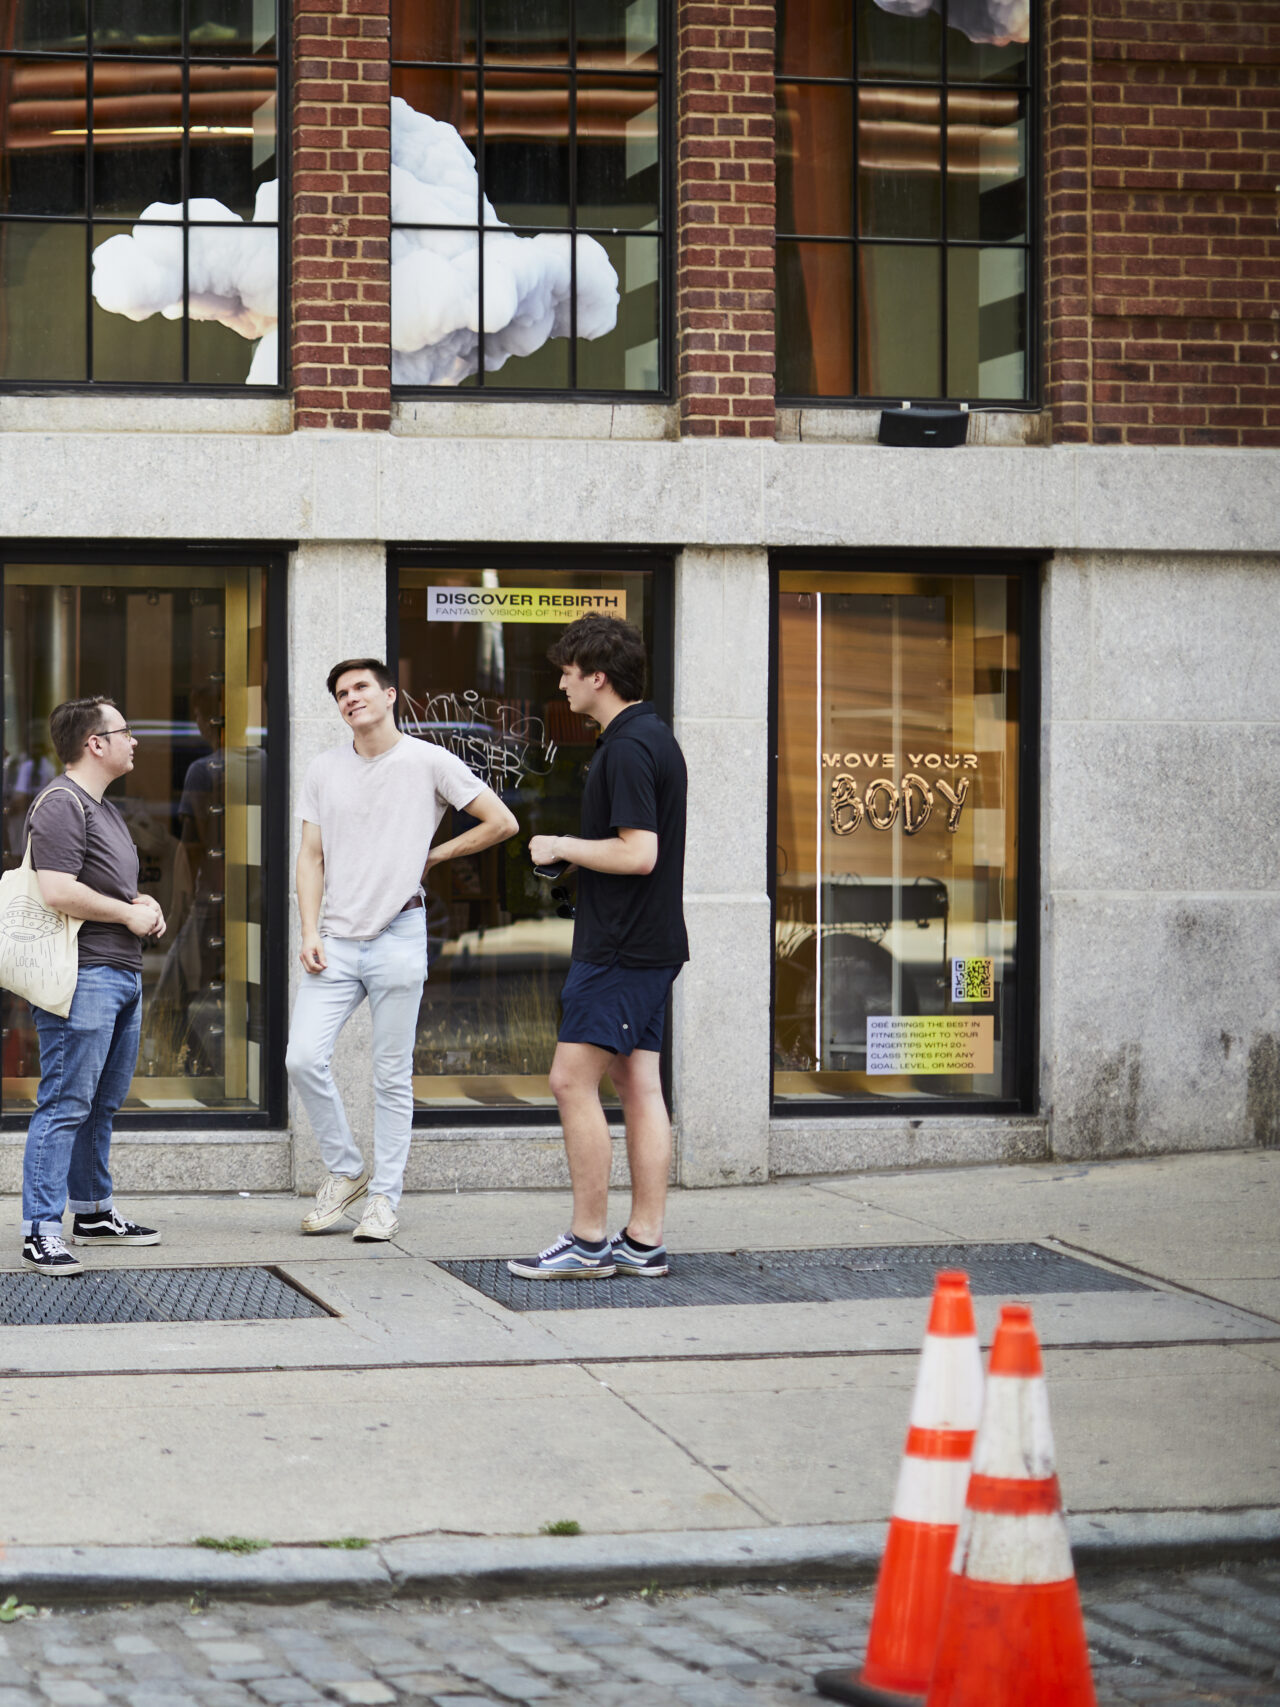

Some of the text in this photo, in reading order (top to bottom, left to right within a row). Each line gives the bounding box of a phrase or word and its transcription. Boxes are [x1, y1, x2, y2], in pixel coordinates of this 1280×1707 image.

[436, 593, 618, 608] DISCOVER REBIRTH
[435, 608, 485, 616] FANTASY
[489, 608, 533, 617] VISIONS
[535, 609, 550, 617] OF
[554, 609, 573, 618] THE
[822, 753, 978, 769] MOVE YOUR
[830, 773, 970, 836] BODY
[15, 955, 41, 969] LOCAL
[870, 1062, 898, 1070] GOAL,
[900, 1062, 929, 1070] LEVEL,
